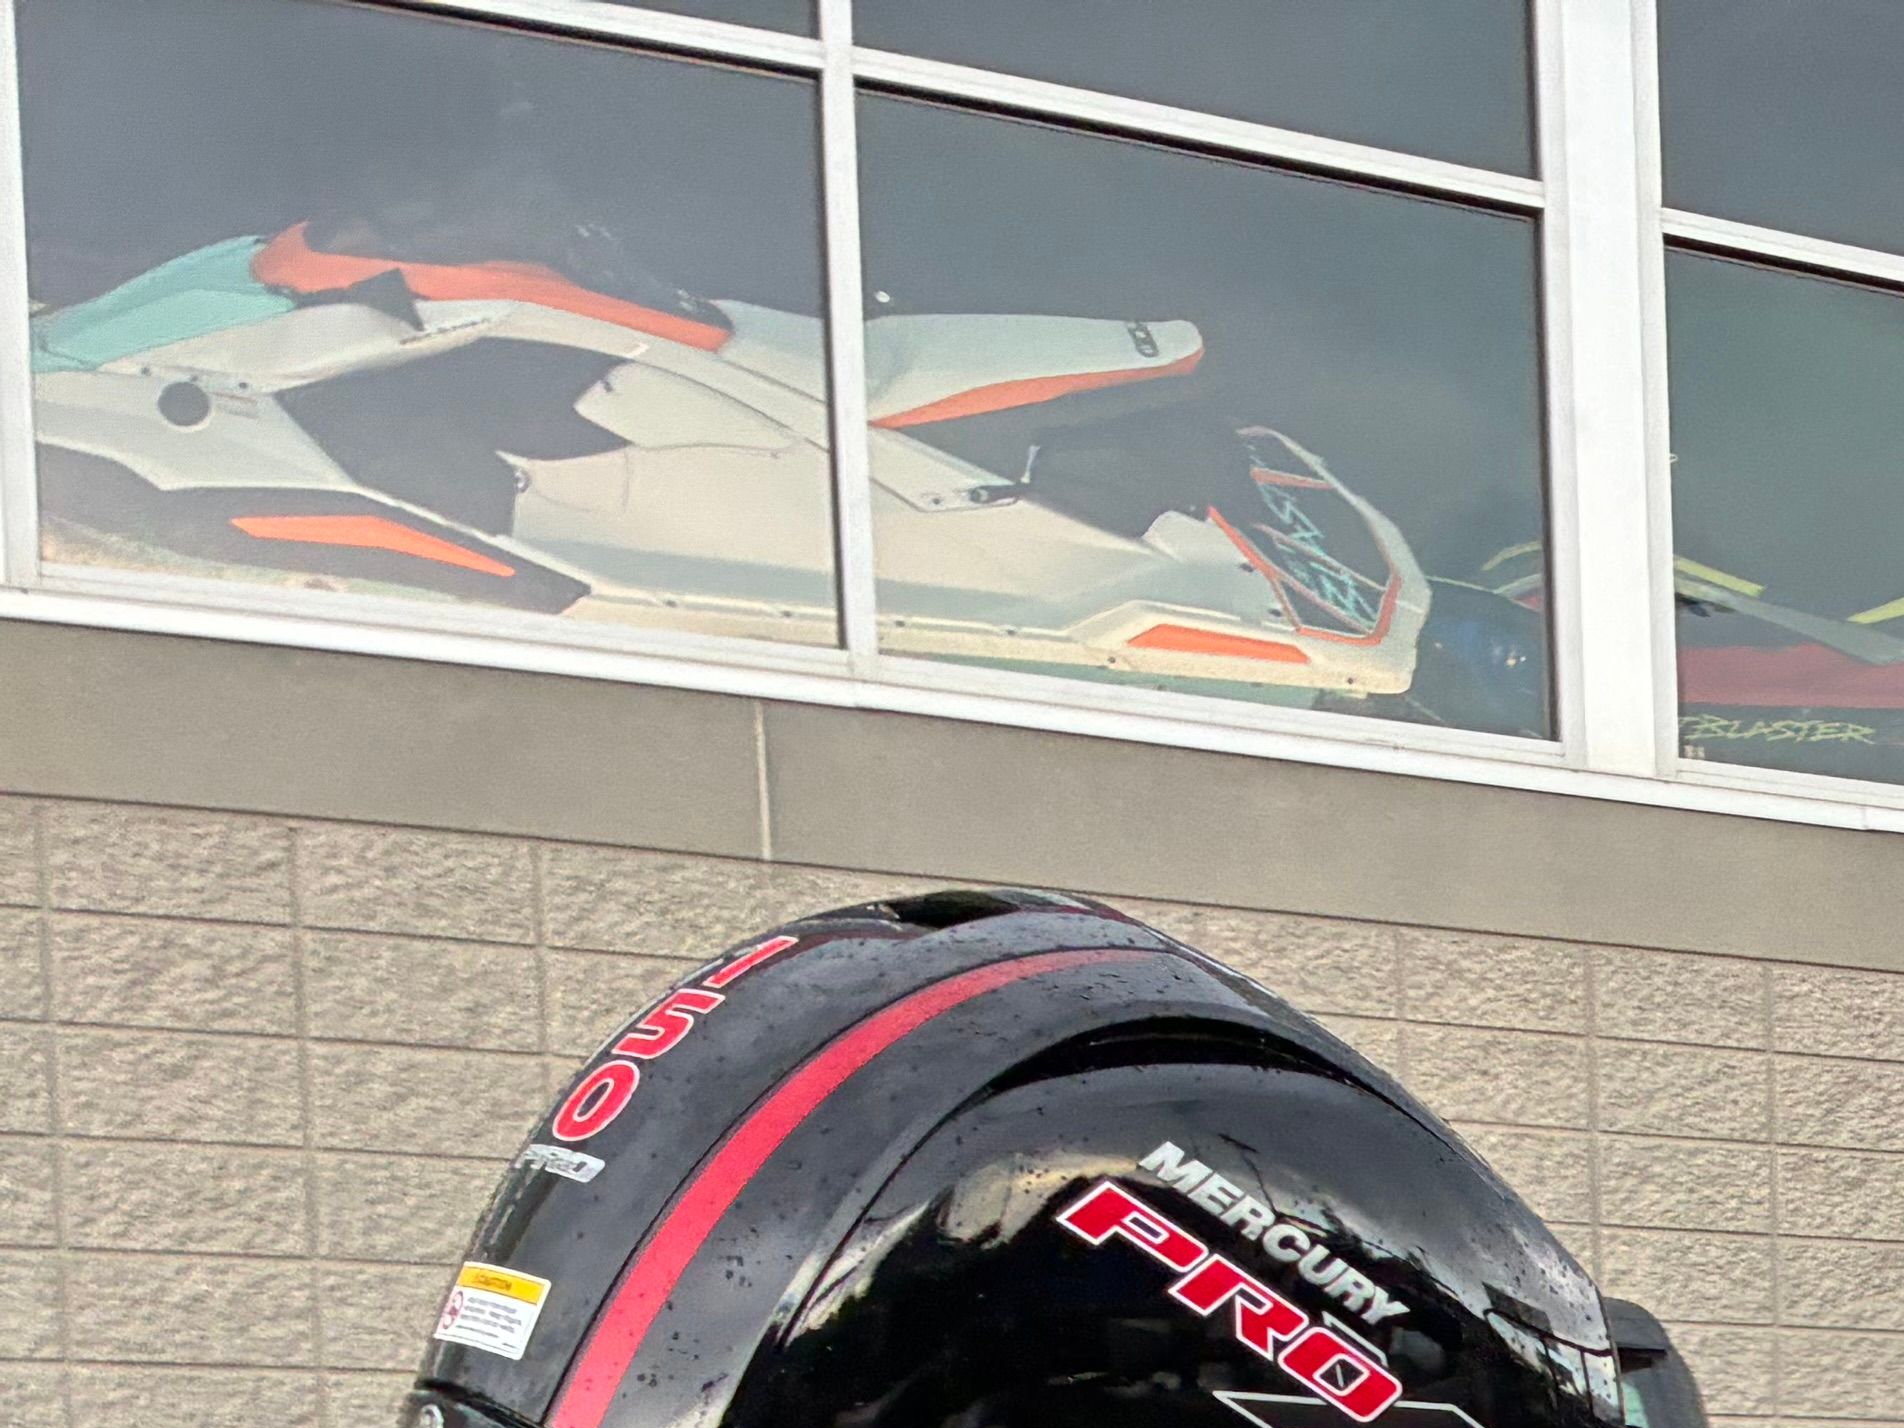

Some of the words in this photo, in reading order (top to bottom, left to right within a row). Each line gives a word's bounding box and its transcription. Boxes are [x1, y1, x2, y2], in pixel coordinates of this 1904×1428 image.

[552, 935, 799, 1142] 150
[1056, 1180, 1404, 1423] PRO
[1136, 1140, 1411, 1327] MERCURY
